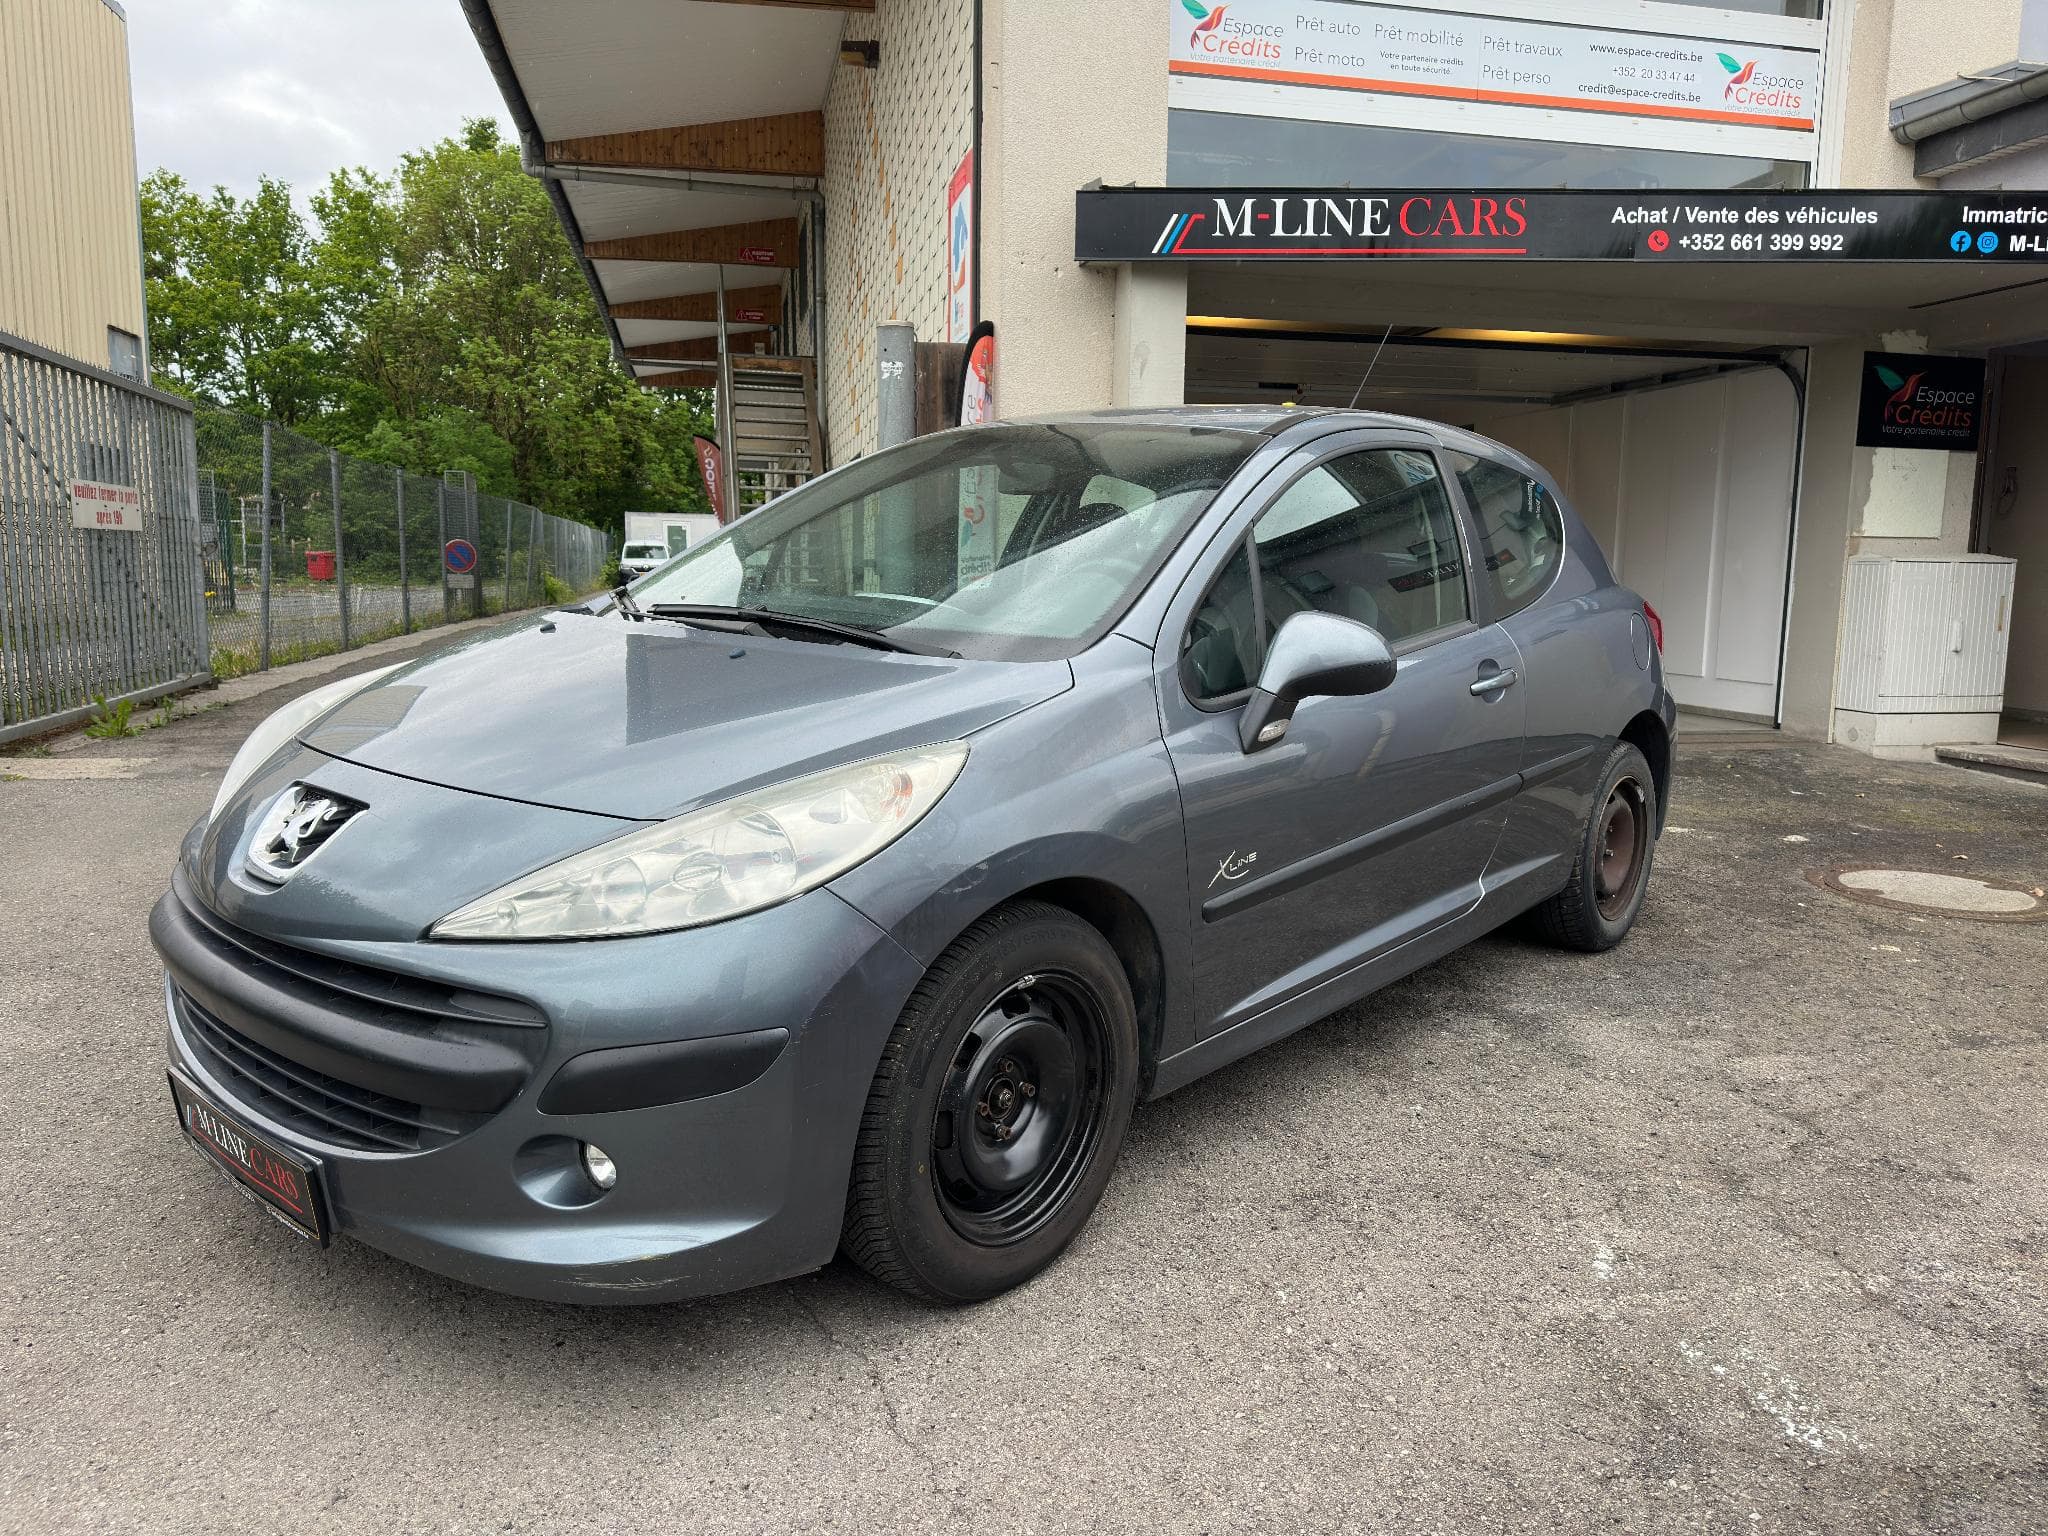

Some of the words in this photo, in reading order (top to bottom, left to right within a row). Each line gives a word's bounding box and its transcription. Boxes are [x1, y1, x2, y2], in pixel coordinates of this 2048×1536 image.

[1223, 17, 1284, 37] Espace
[1296, 15, 1325, 32] Prêt
[1329, 22, 1360, 36] auto
[1375, 23, 1402, 41] Prêt
[1407, 29, 1464, 47] mobilité
[1203, 34, 1281, 58] Crédits
[1483, 35, 1511, 52] Prêt
[1514, 40, 1563, 57] travaux
[1589, 43, 1703, 63] www.espace-credits.be
[1295, 46, 1323, 64] Prêt
[1328, 54, 1365, 67] moto
[1380, 50, 1400, 60] Votre
[1401, 54, 1438, 64] partenaire
[1401, 63, 1421, 72] toute
[1482, 64, 1510, 81] Prêt
[1513, 71, 1551, 86] perso
[1612, 66, 1636, 78] +352
[1641, 68, 1653, 79] 20
[1655, 69, 1667, 81] 33
[1669, 71, 1681, 82] 47
[1683, 73, 1696, 83] 44
[1752, 72, 1804, 90] Espace
[1578, 83, 1701, 103] credit@espace-credits.be
[1735, 87, 1801, 109] Crédits
[1211, 197, 1391, 238] M-LINE
[1399, 197, 1527, 238] CARS
[1610, 206, 1669, 224] Achat
[1672, 206, 1681, 224] /
[1685, 206, 1739, 224] Vente
[1744, 206, 1780, 224] des
[1785, 206, 1878, 224] véhicules
[1962, 205, 2048, 224] Immatric
[1678, 233, 1726, 251] +352
[1730, 233, 1763, 251] 661
[1769, 233, 1804, 251] 399
[1809, 234, 1844, 251] 992
[1916, 386, 1975, 406] Espace
[1895, 404, 1972, 428] Crédits
[195, 1103, 251, 1168] M-LINE
[250, 1147, 299, 1200] CARS
